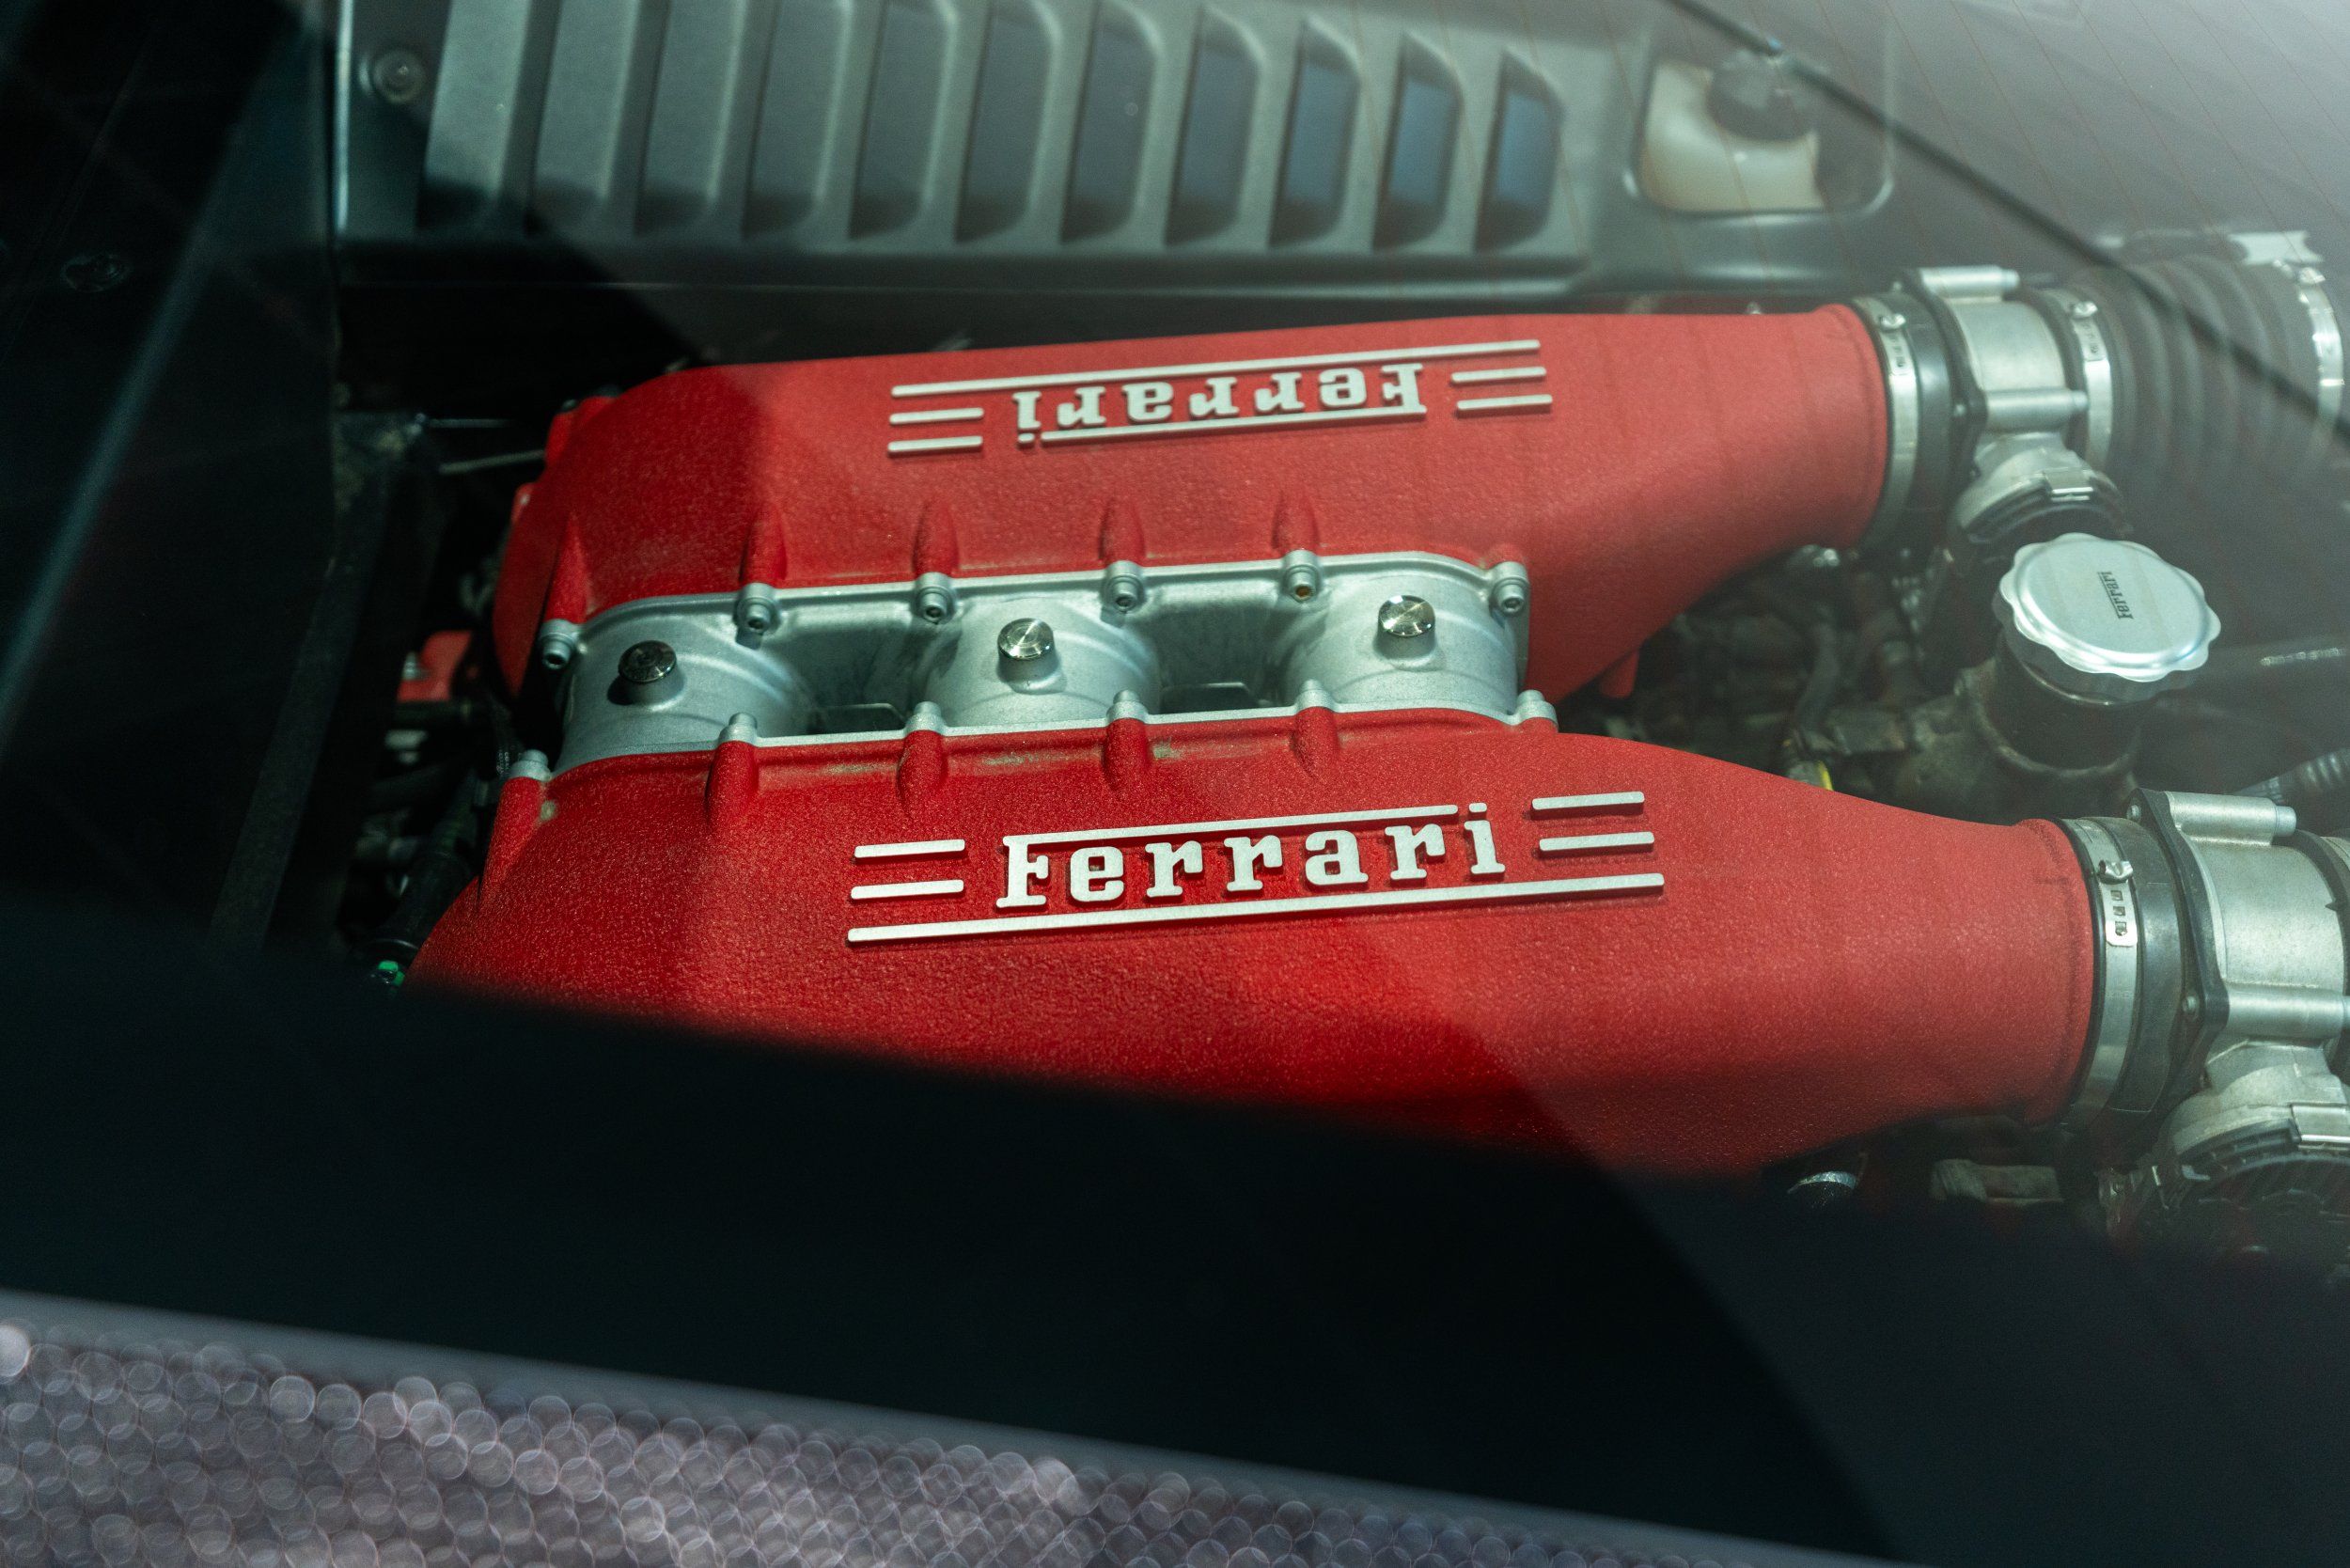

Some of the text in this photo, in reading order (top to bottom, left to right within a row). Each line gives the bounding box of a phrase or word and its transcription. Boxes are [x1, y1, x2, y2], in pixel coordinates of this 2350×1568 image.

[1012, 363, 1427, 444] Ferrari
[2097, 571, 2134, 619] Ferrari
[995, 802, 1506, 909] Ferrari
